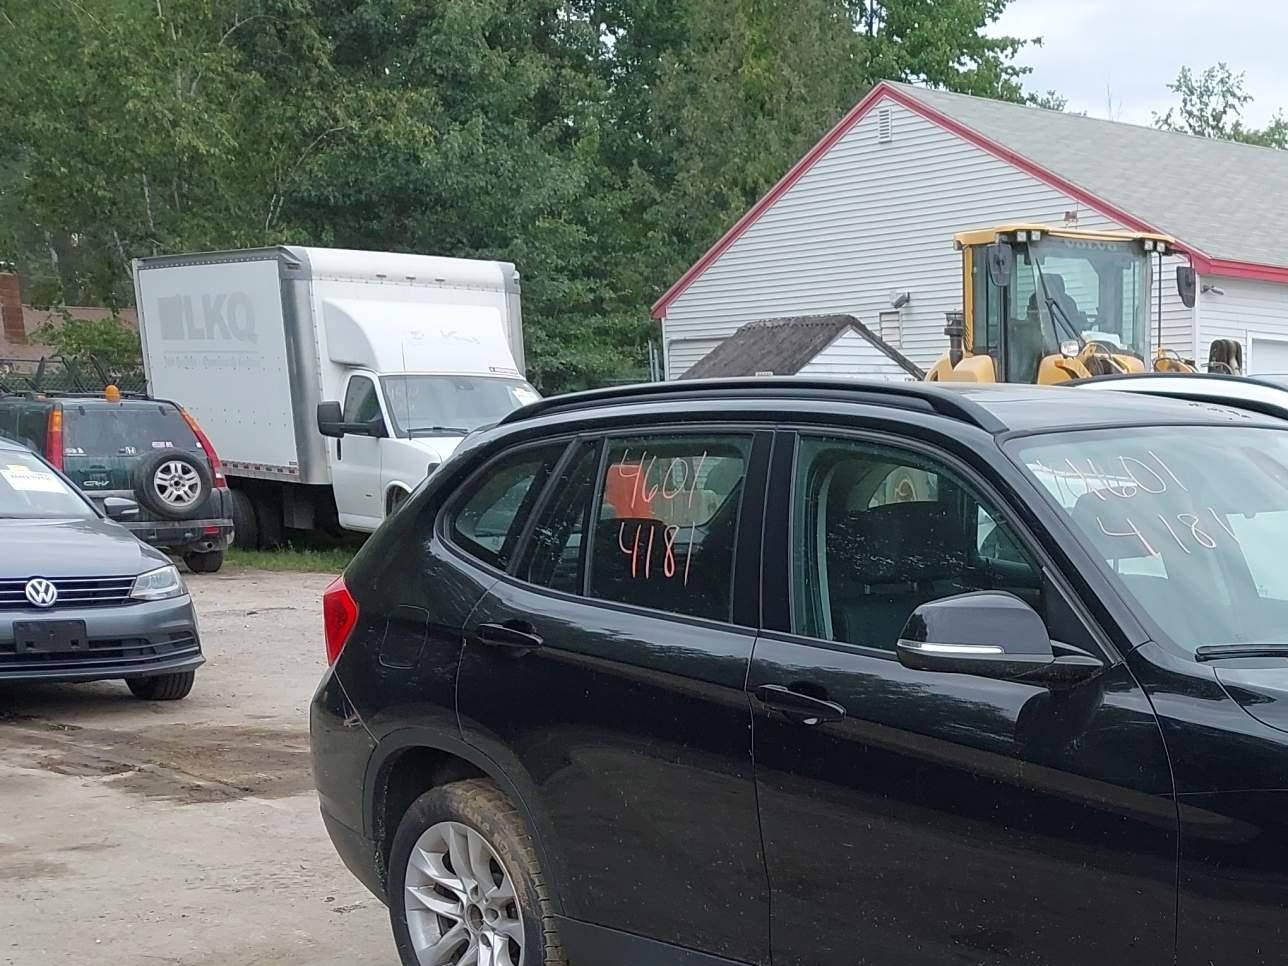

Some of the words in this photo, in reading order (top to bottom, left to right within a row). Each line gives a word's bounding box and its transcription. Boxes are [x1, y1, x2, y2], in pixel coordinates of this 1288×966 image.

[1065, 240, 1116, 251] VOLVO
[181, 292, 259, 344] LKQ
[619, 449, 707, 509] 4601
[619, 520, 696, 588] 4181
[1096, 507, 1241, 559] 4181
